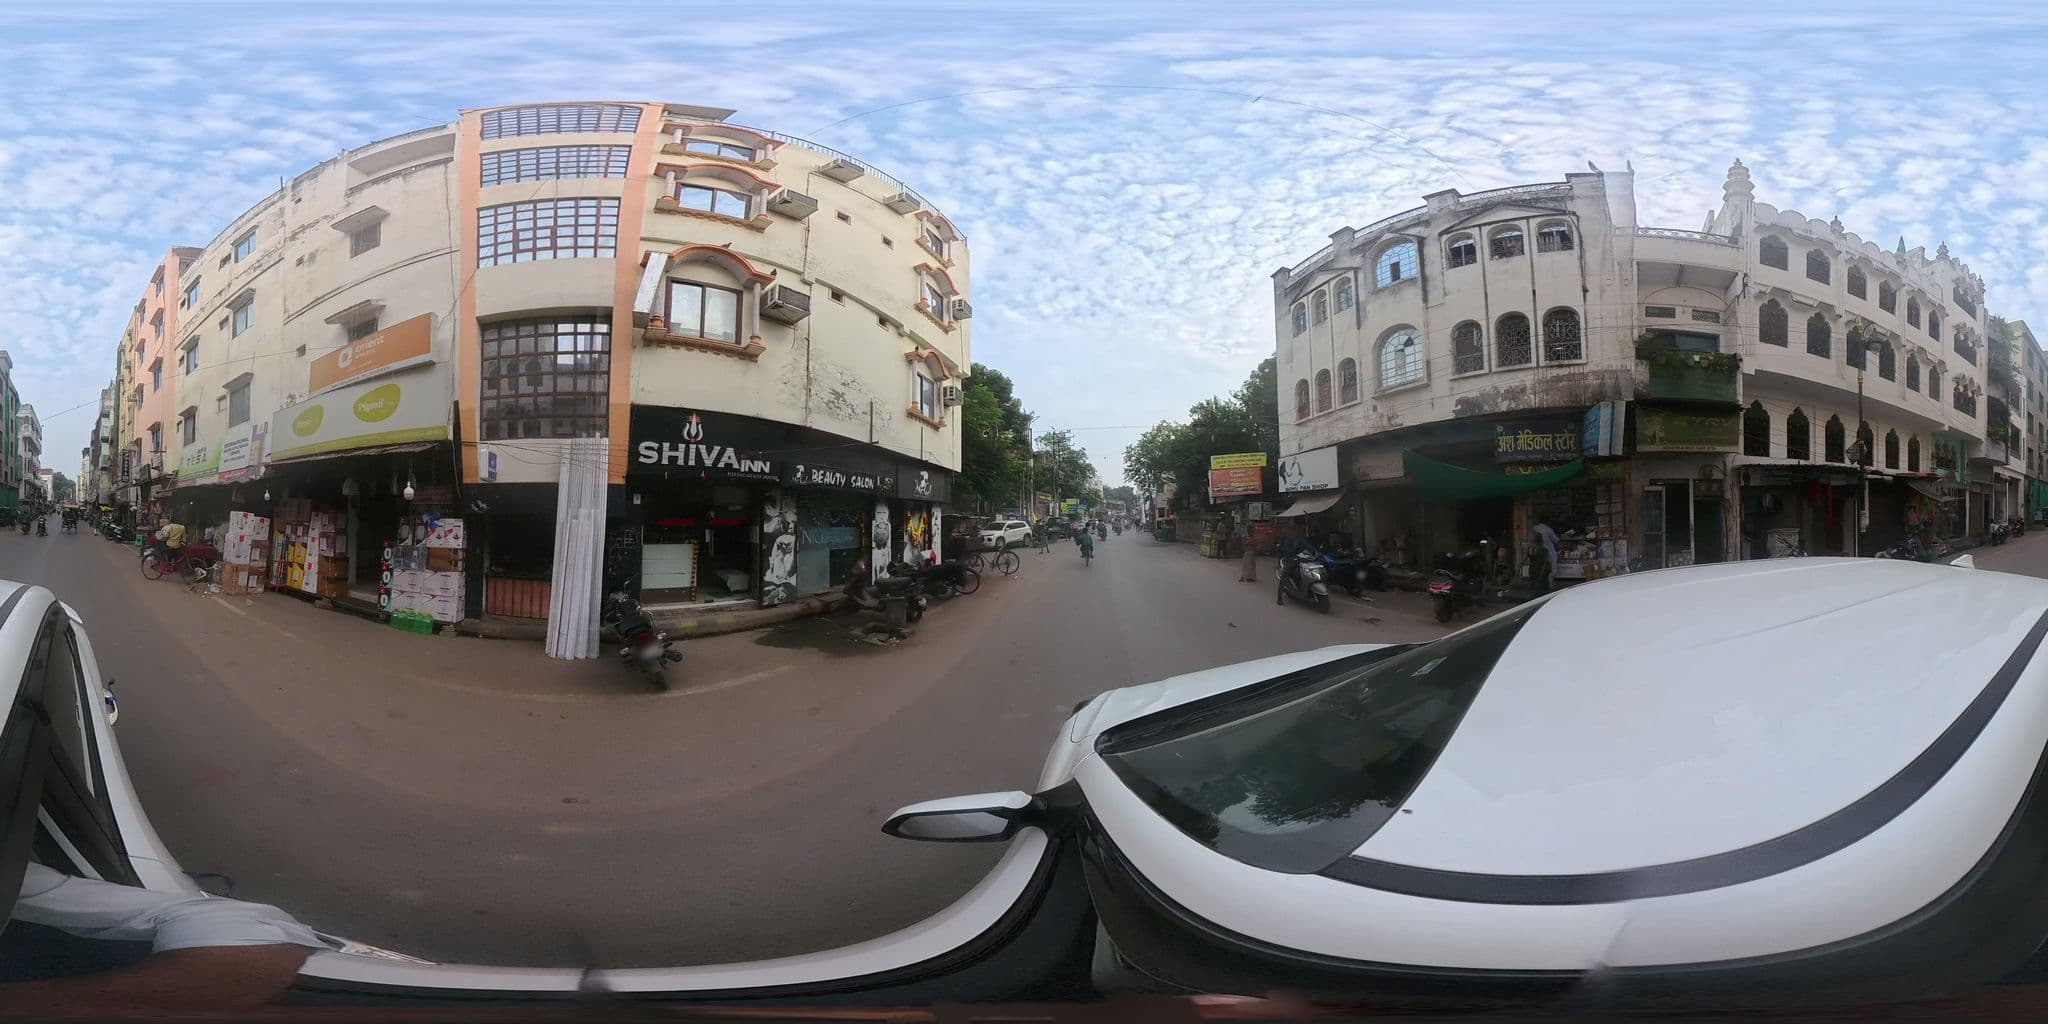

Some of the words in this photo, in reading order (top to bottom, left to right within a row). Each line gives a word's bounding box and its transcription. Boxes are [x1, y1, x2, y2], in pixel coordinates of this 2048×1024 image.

[1516, 429, 1553, 451] मेडिकल
[638, 441, 741, 469] SHIVA
[740, 459, 771, 474] INN
[811, 469, 846, 488] BEAUTY
[850, 475, 875, 490] SALON
